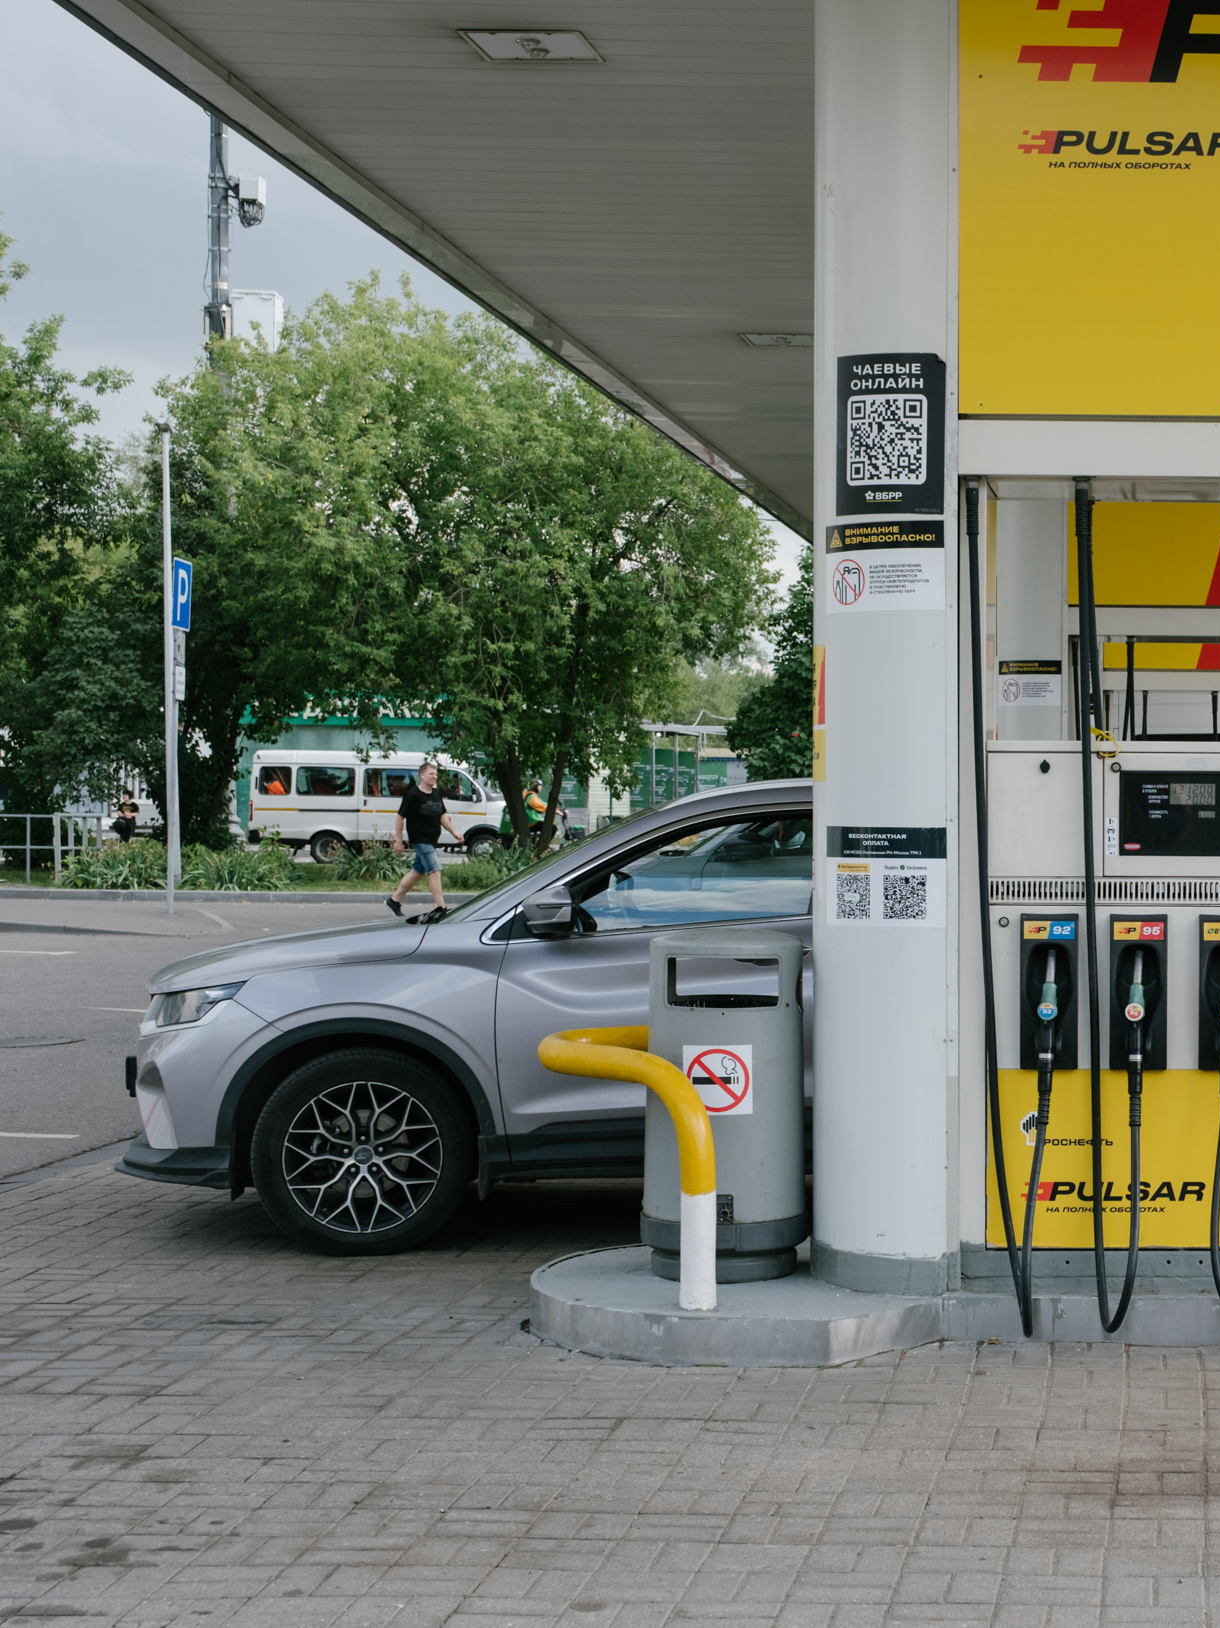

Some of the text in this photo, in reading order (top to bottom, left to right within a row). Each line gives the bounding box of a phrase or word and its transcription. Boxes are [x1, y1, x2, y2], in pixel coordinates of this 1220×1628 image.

[1048, 161, 1192, 170] НА ПОЛНЫХ ОБОРОТАХ
[853, 363, 921, 375] ЧАЕВЫЕ
[850, 375, 924, 390] ОНЛАЙН
[875, 492, 902, 500] ВБРР
[845, 526, 899, 536] ВНИМАНИЕ
[845, 534, 936, 545] ВЗРЫВООПАСНО!
[177, 568, 188, 621] P
[1052, 926, 1071, 934] 92
[1142, 926, 1160, 935] 95
